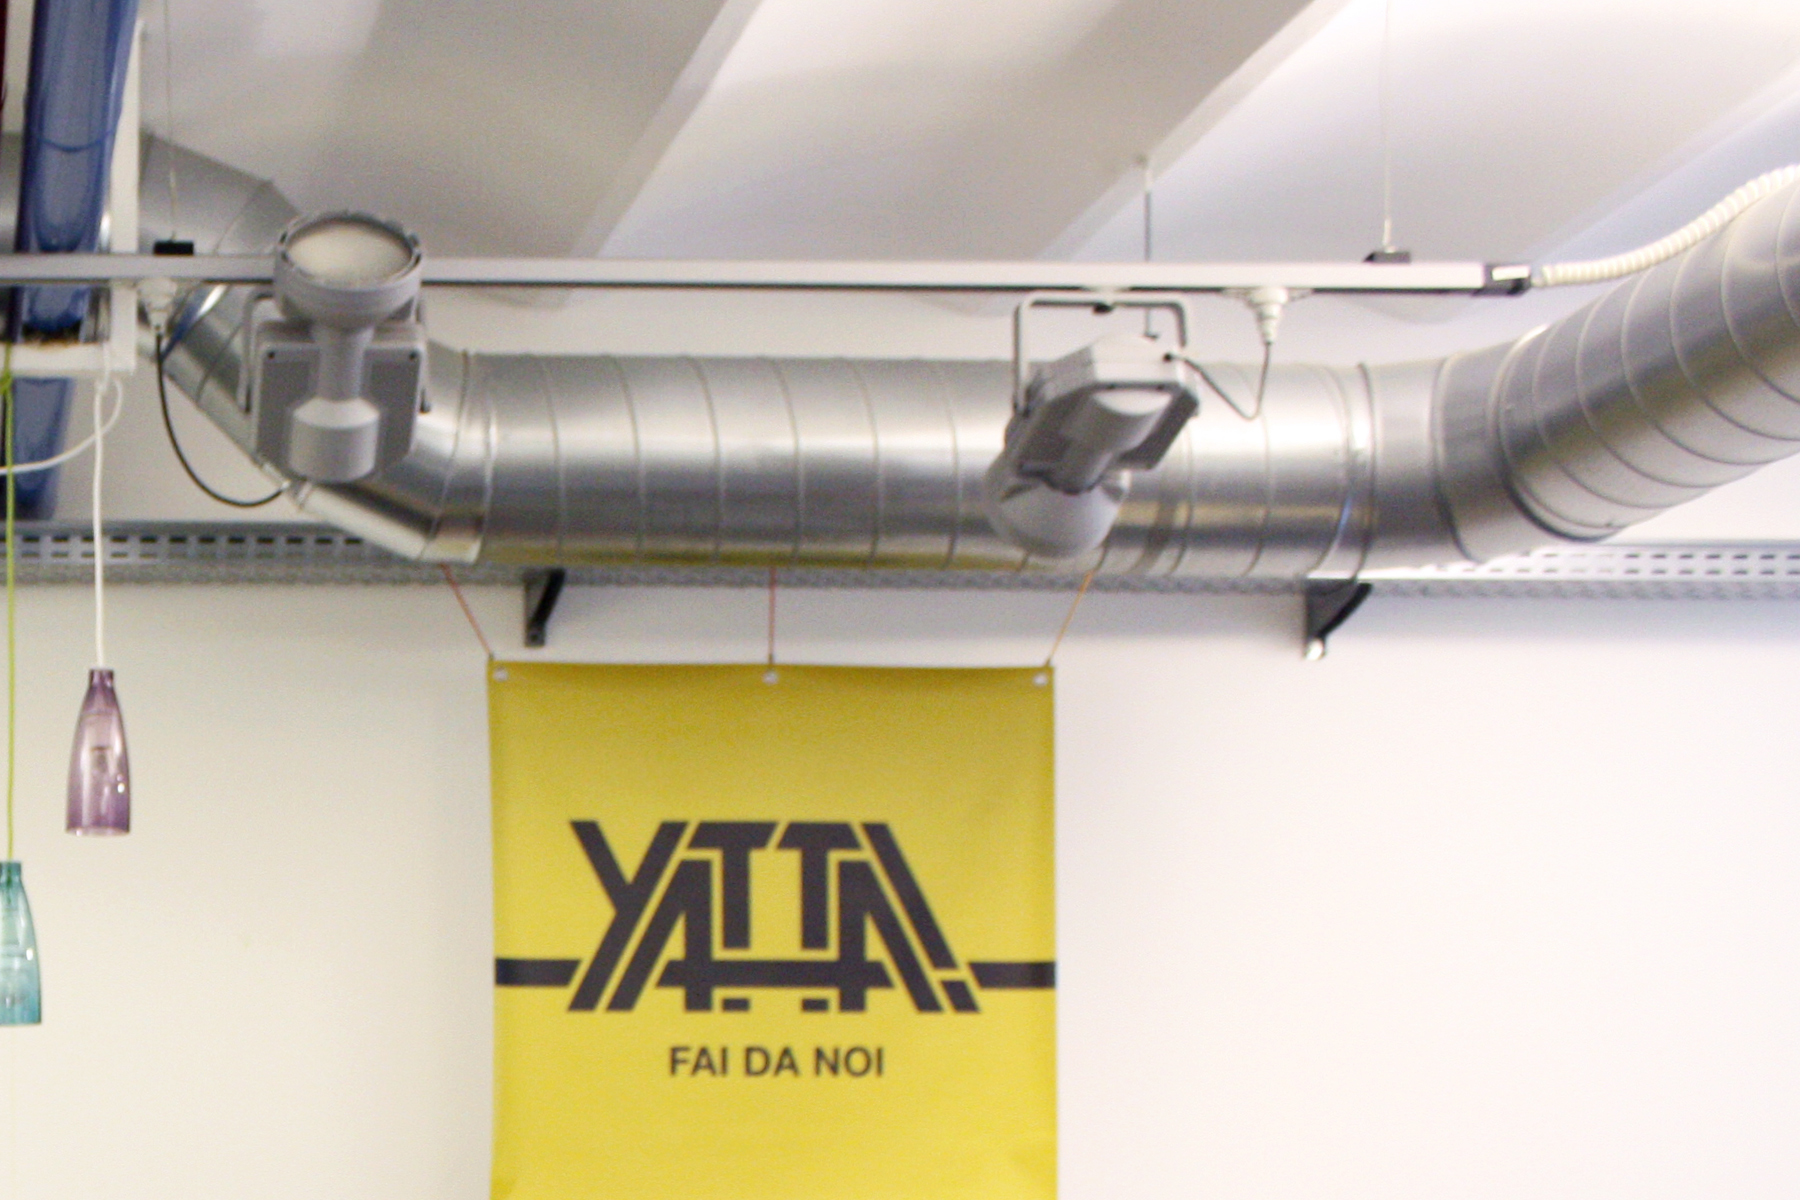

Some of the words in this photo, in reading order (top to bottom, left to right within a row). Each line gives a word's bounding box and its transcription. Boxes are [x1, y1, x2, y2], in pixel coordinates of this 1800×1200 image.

[669, 1046, 729, 1077] FAI
[744, 1046, 800, 1077] DA
[814, 1047, 885, 1077] NOI
